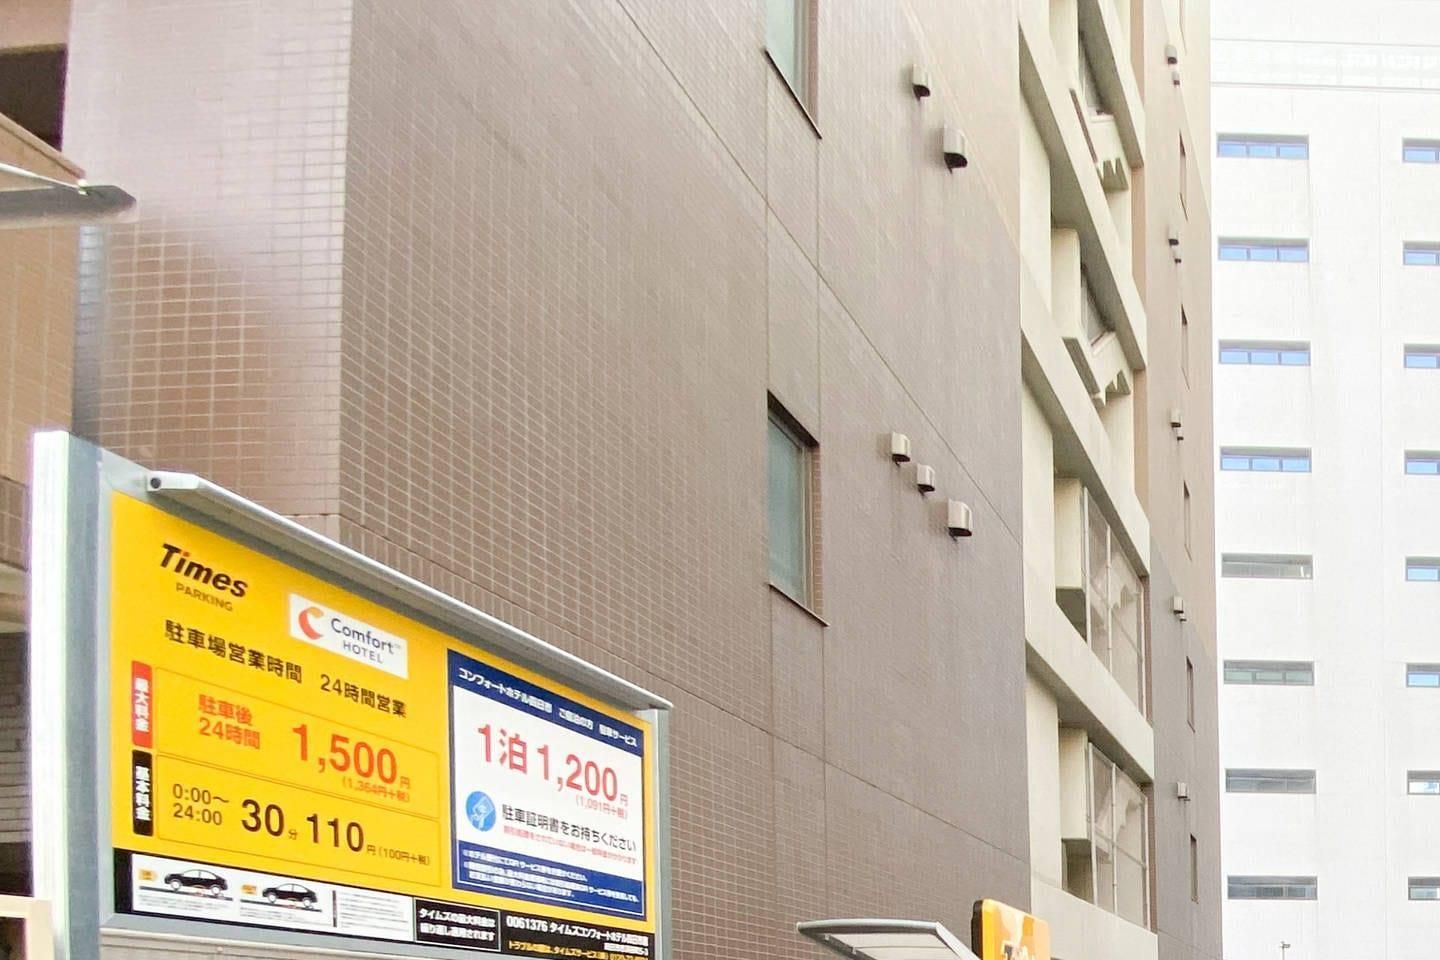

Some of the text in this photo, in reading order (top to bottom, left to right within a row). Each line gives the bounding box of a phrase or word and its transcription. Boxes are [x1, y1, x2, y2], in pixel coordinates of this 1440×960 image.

[162, 543, 248, 598] Times
[175, 582, 233, 612] PARKING
[331, 618, 394, 654] Comfort
[165, 619, 408, 718] 駐車場営業時間 24時間営業
[343, 641, 383, 664] HOTEL
[199, 694, 253, 726] 駐車後
[199, 718, 261, 750] 24時間
[172, 803, 222, 826] 24:00
[502, 803, 637, 852] 駐車証明書をお持ちください
